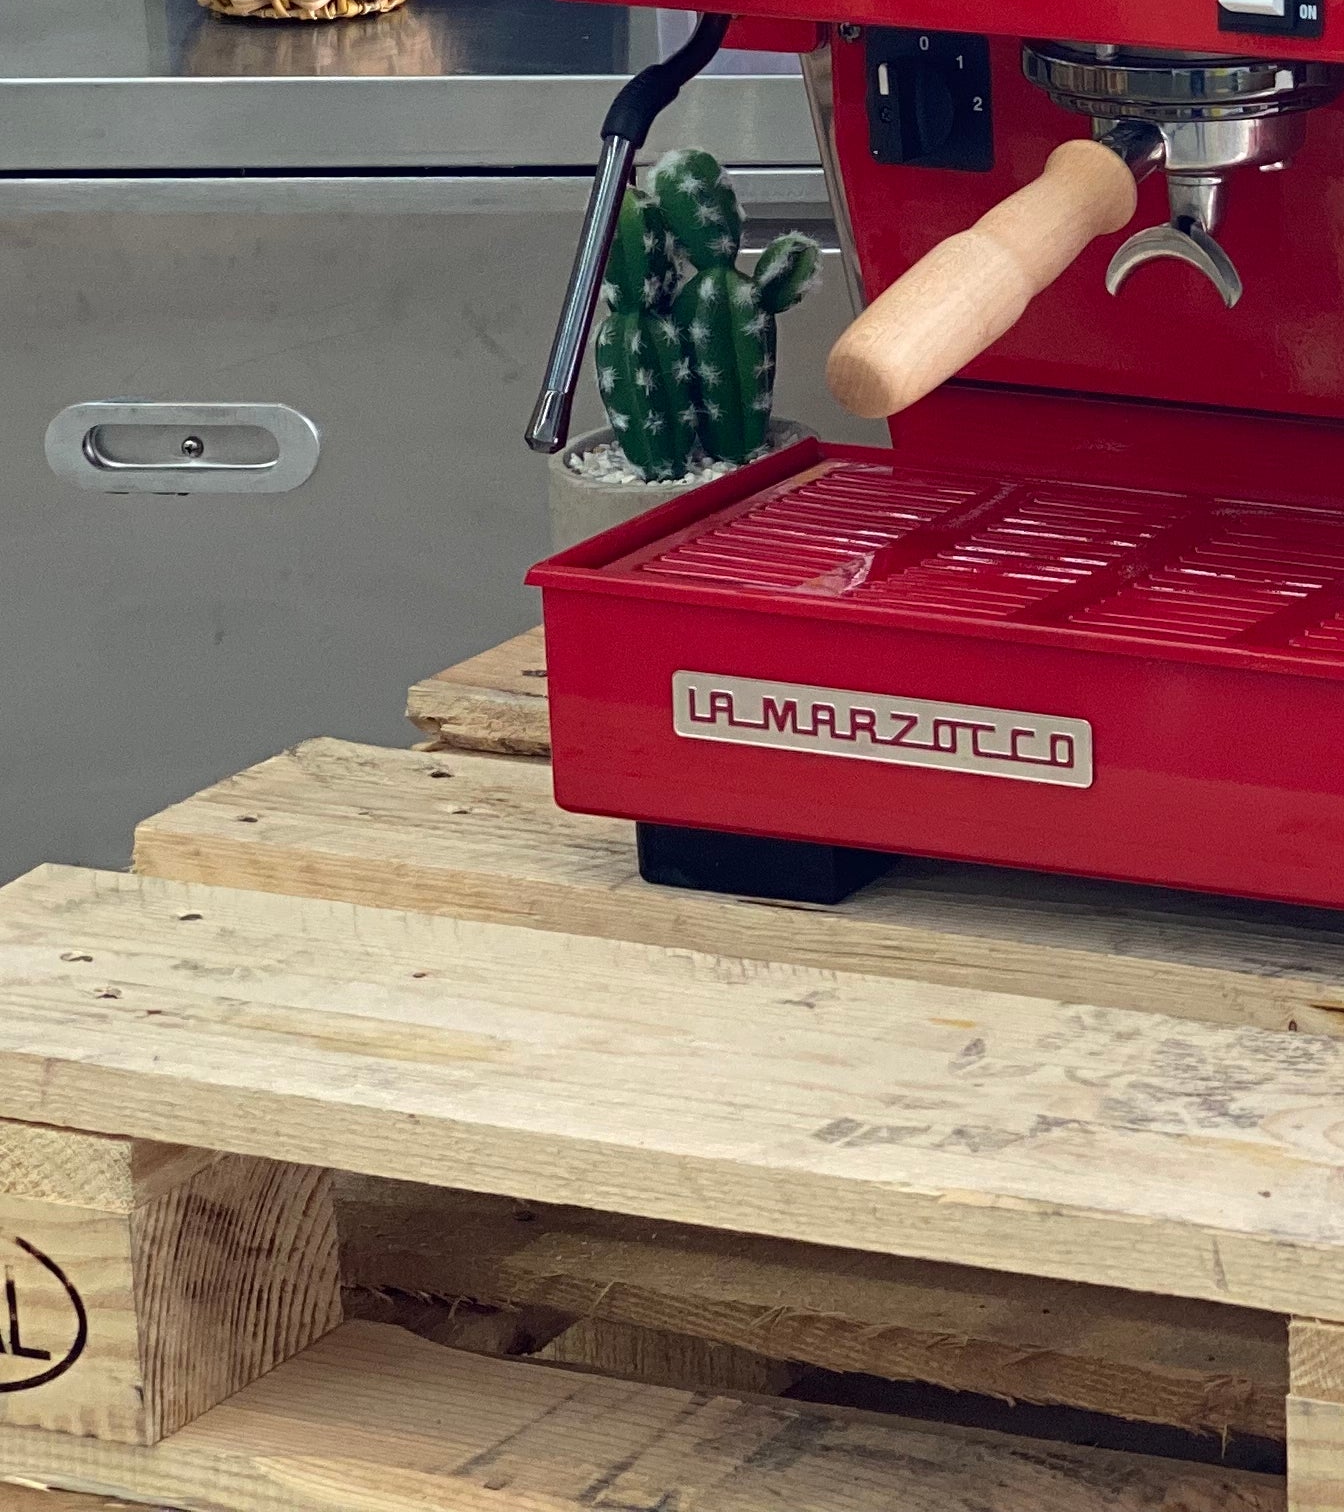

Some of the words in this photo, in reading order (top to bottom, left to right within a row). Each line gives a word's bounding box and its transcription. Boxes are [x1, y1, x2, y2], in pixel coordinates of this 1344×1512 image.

[1298, 4, 1318, 20] ON
[919, 36, 929, 51] 0
[955, 54, 964, 70] 1
[972, 96, 983, 112] 2
[688, 687, 734, 726] LA
